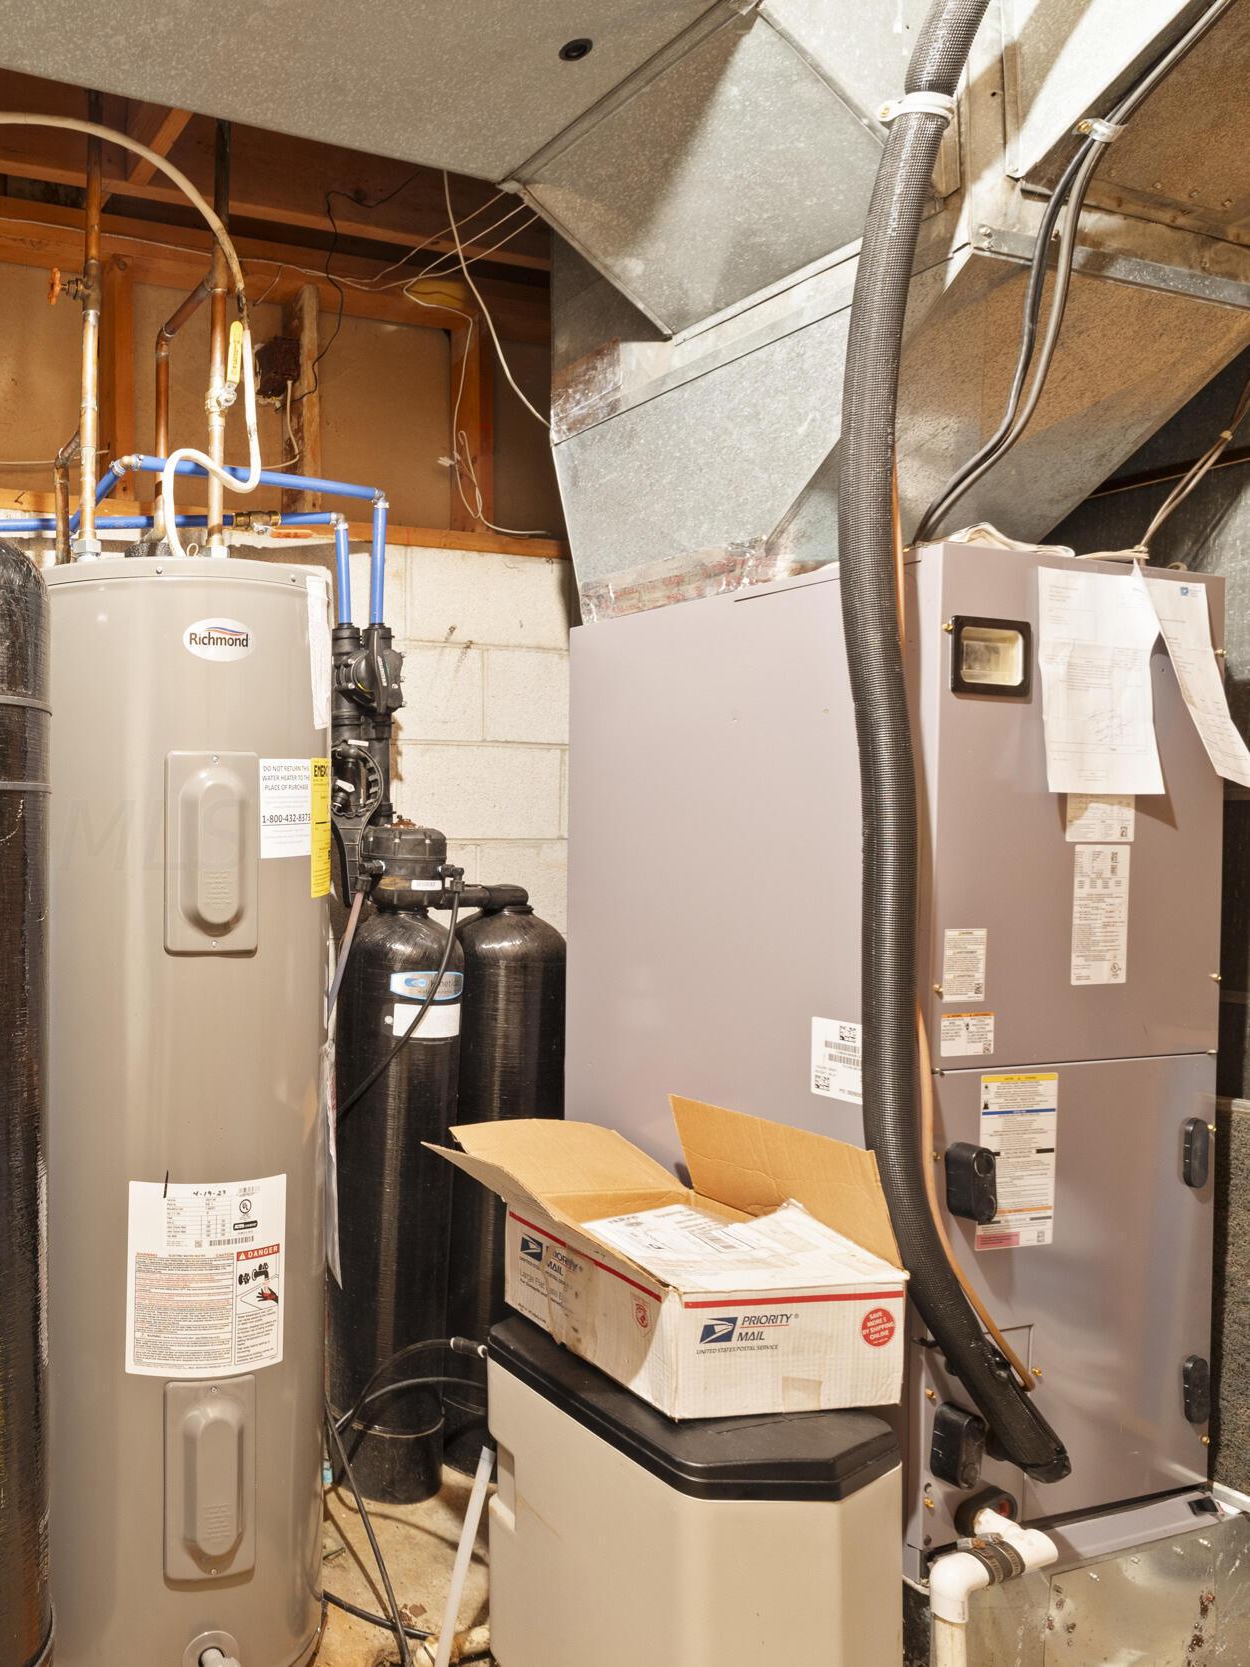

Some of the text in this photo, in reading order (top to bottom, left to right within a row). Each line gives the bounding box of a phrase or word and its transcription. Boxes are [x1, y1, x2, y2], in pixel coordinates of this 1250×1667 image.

[189, 632, 249, 648] Richmond
[247, 1245, 279, 1258] DANGER
[741, 1313, 793, 1326] PRIORITY
[737, 1331, 765, 1342] MAIL
